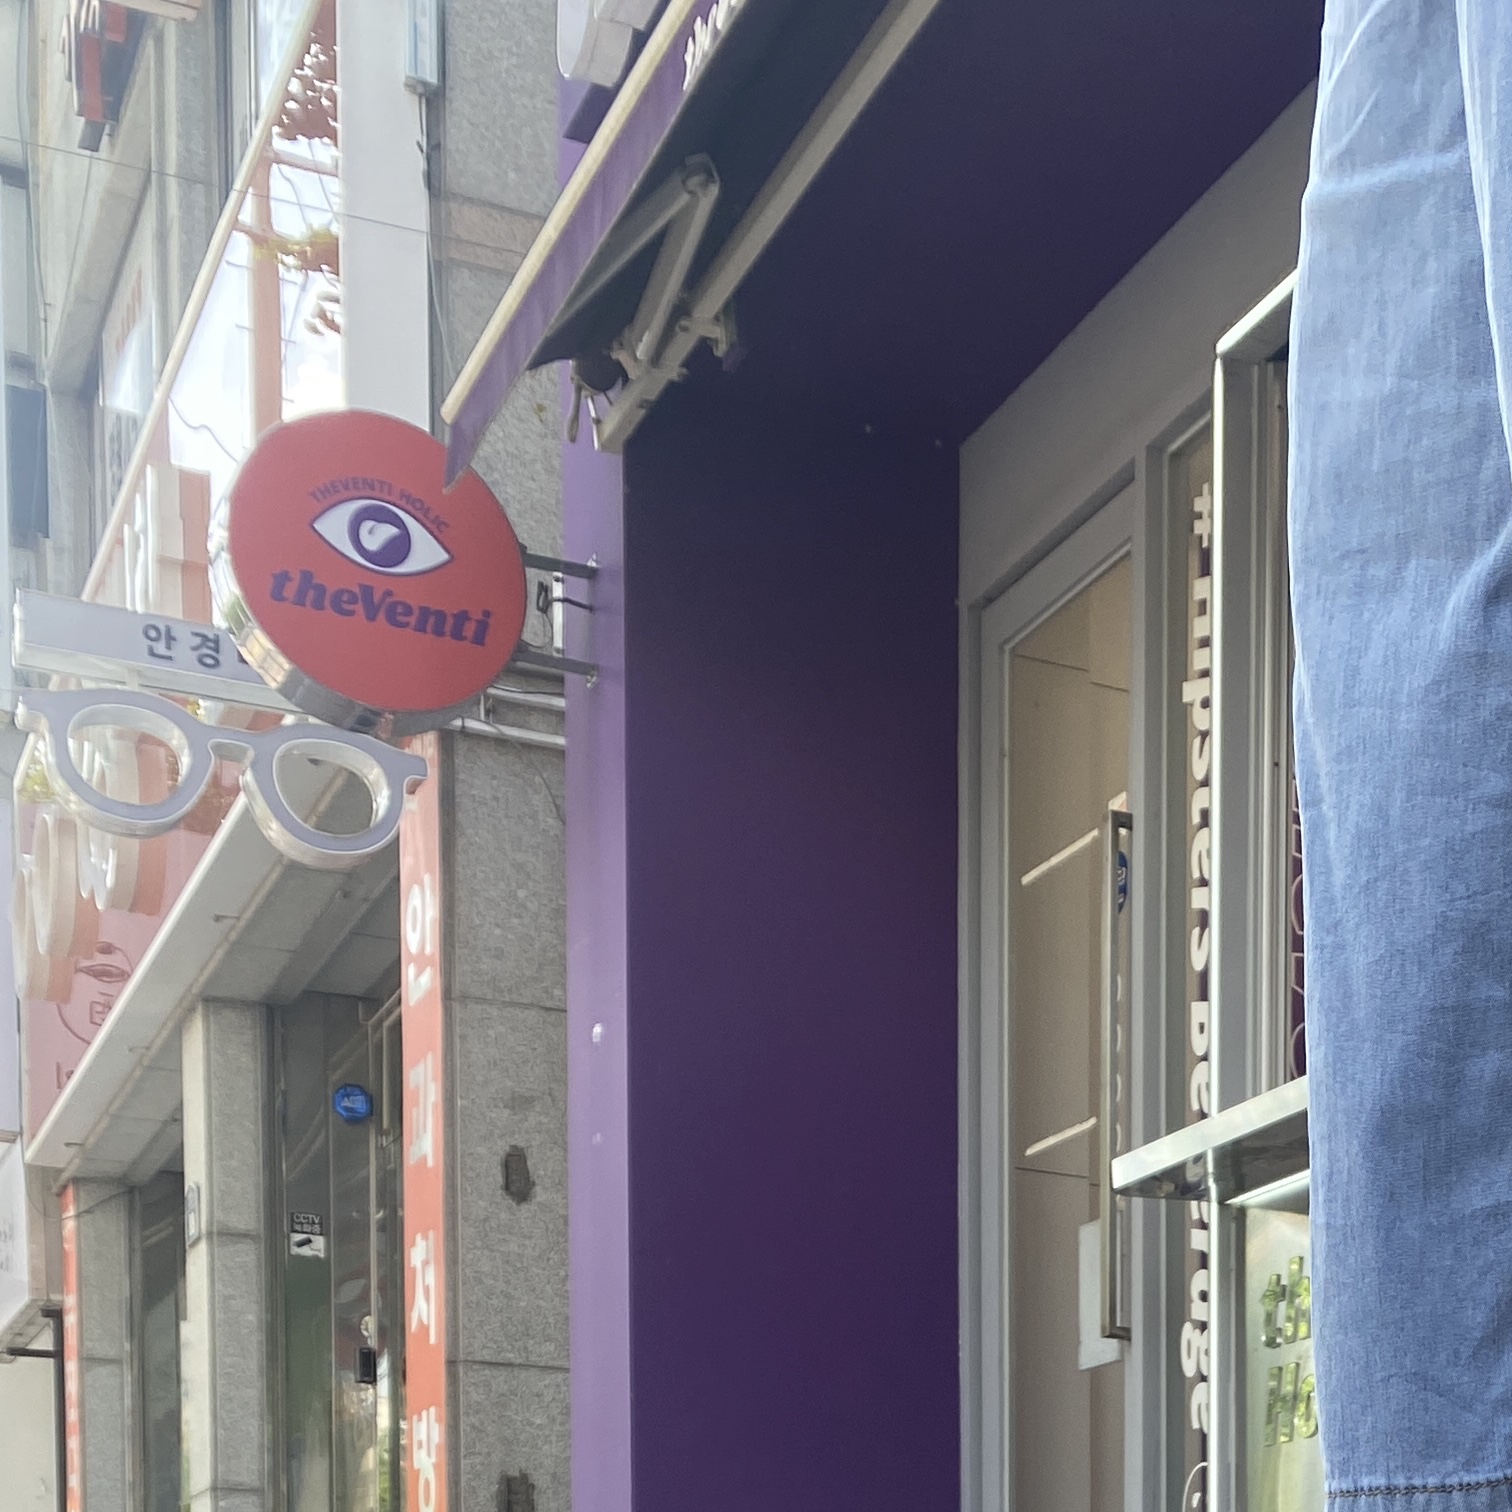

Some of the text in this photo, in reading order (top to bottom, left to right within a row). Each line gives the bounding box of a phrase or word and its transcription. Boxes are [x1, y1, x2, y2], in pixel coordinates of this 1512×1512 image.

[310, 477, 450, 534] THEVENTI HOLIC
[269, 568, 491, 647] theVenti
[142, 623, 248, 669] 안경
[293, 1212, 320, 1224] CCTV
